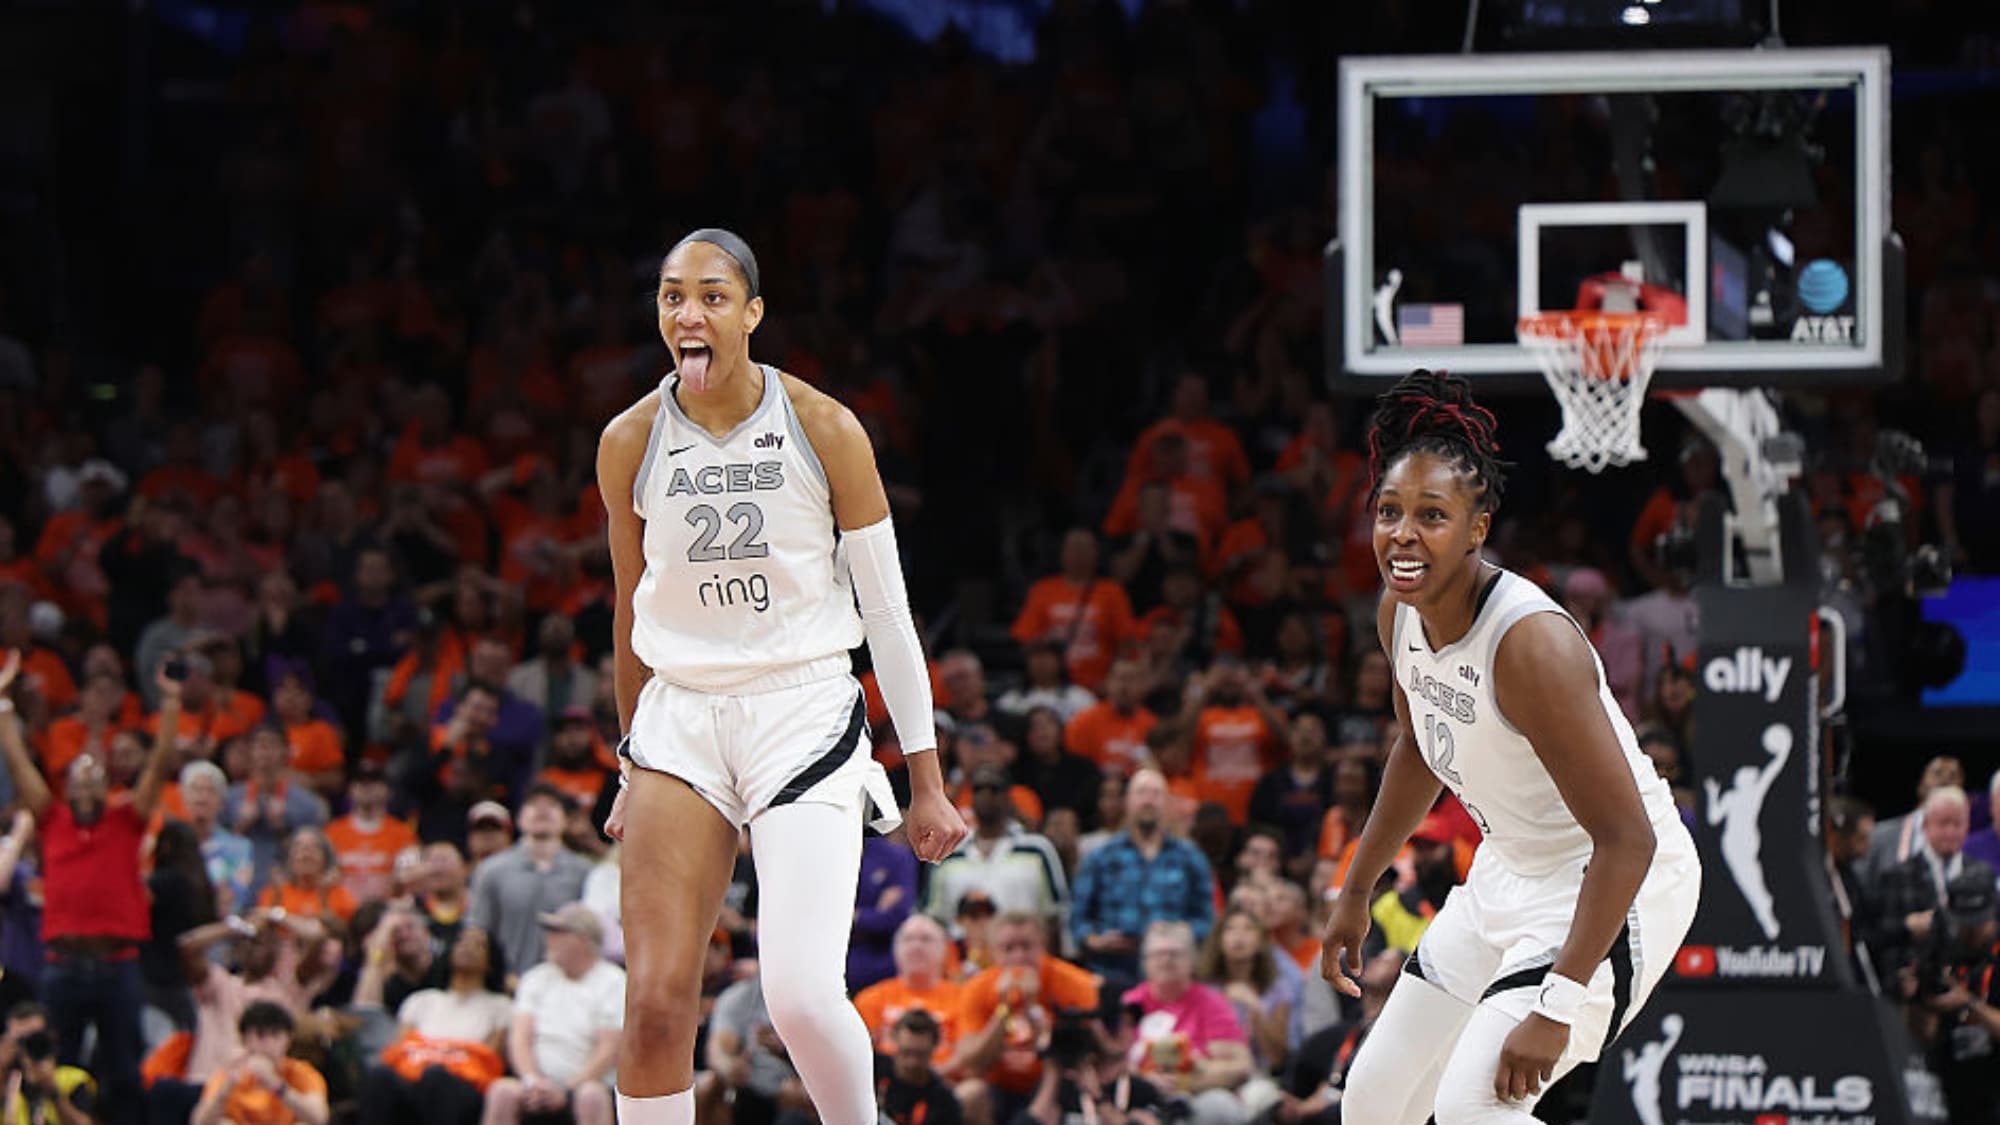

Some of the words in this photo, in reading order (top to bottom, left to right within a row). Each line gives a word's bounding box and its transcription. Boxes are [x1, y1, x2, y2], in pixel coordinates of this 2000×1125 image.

[1790, 315, 1854, 342] AT&T
[754, 431, 784, 450] ally
[665, 460, 785, 497] ACES
[684, 502, 770, 562] 22
[698, 573, 770, 613] ring
[1458, 665, 1480, 687] ally
[1703, 645, 1793, 702] ally
[1409, 665, 1476, 725] ACES
[1424, 714, 1463, 785] 12
[1678, 1053, 1767, 1075] WNBA
[1677, 1075, 1874, 1112] FINALS
